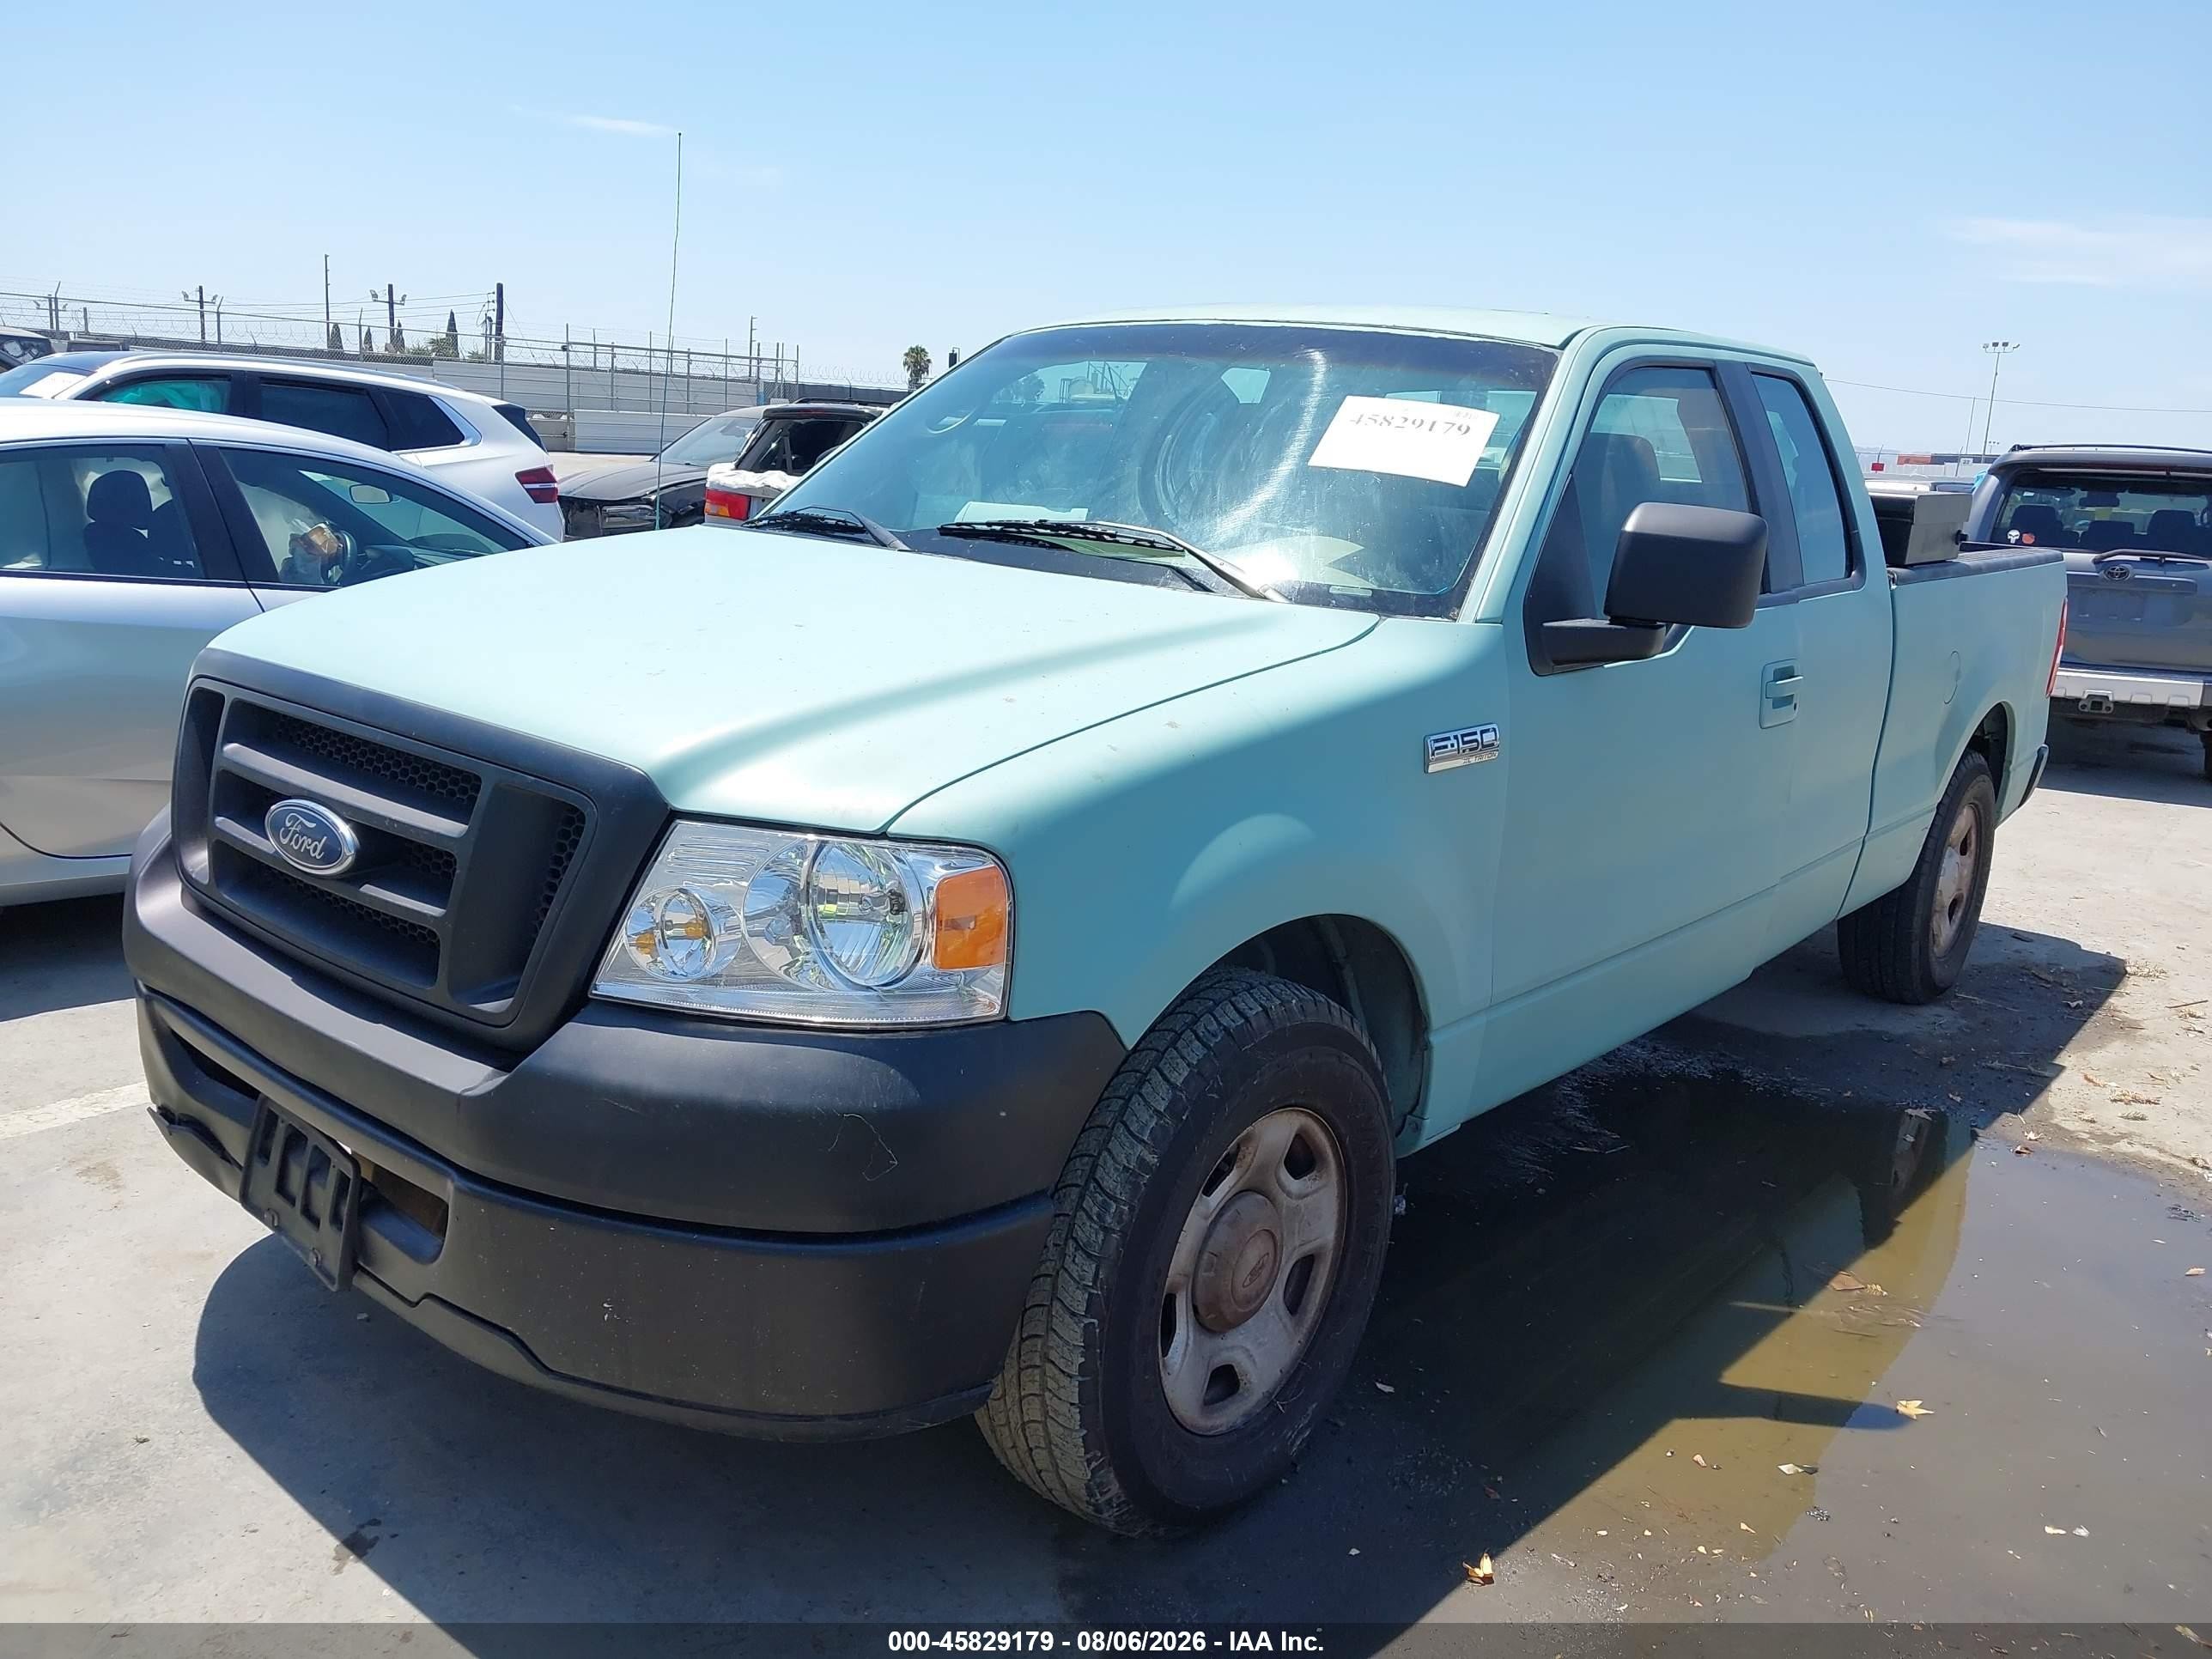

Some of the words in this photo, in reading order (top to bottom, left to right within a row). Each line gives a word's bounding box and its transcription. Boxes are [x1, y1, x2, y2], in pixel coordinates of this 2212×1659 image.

[1350, 413, 1471, 436] 45829179
[1430, 728, 1498, 760] F-150
[279, 812, 327, 860] Ford
